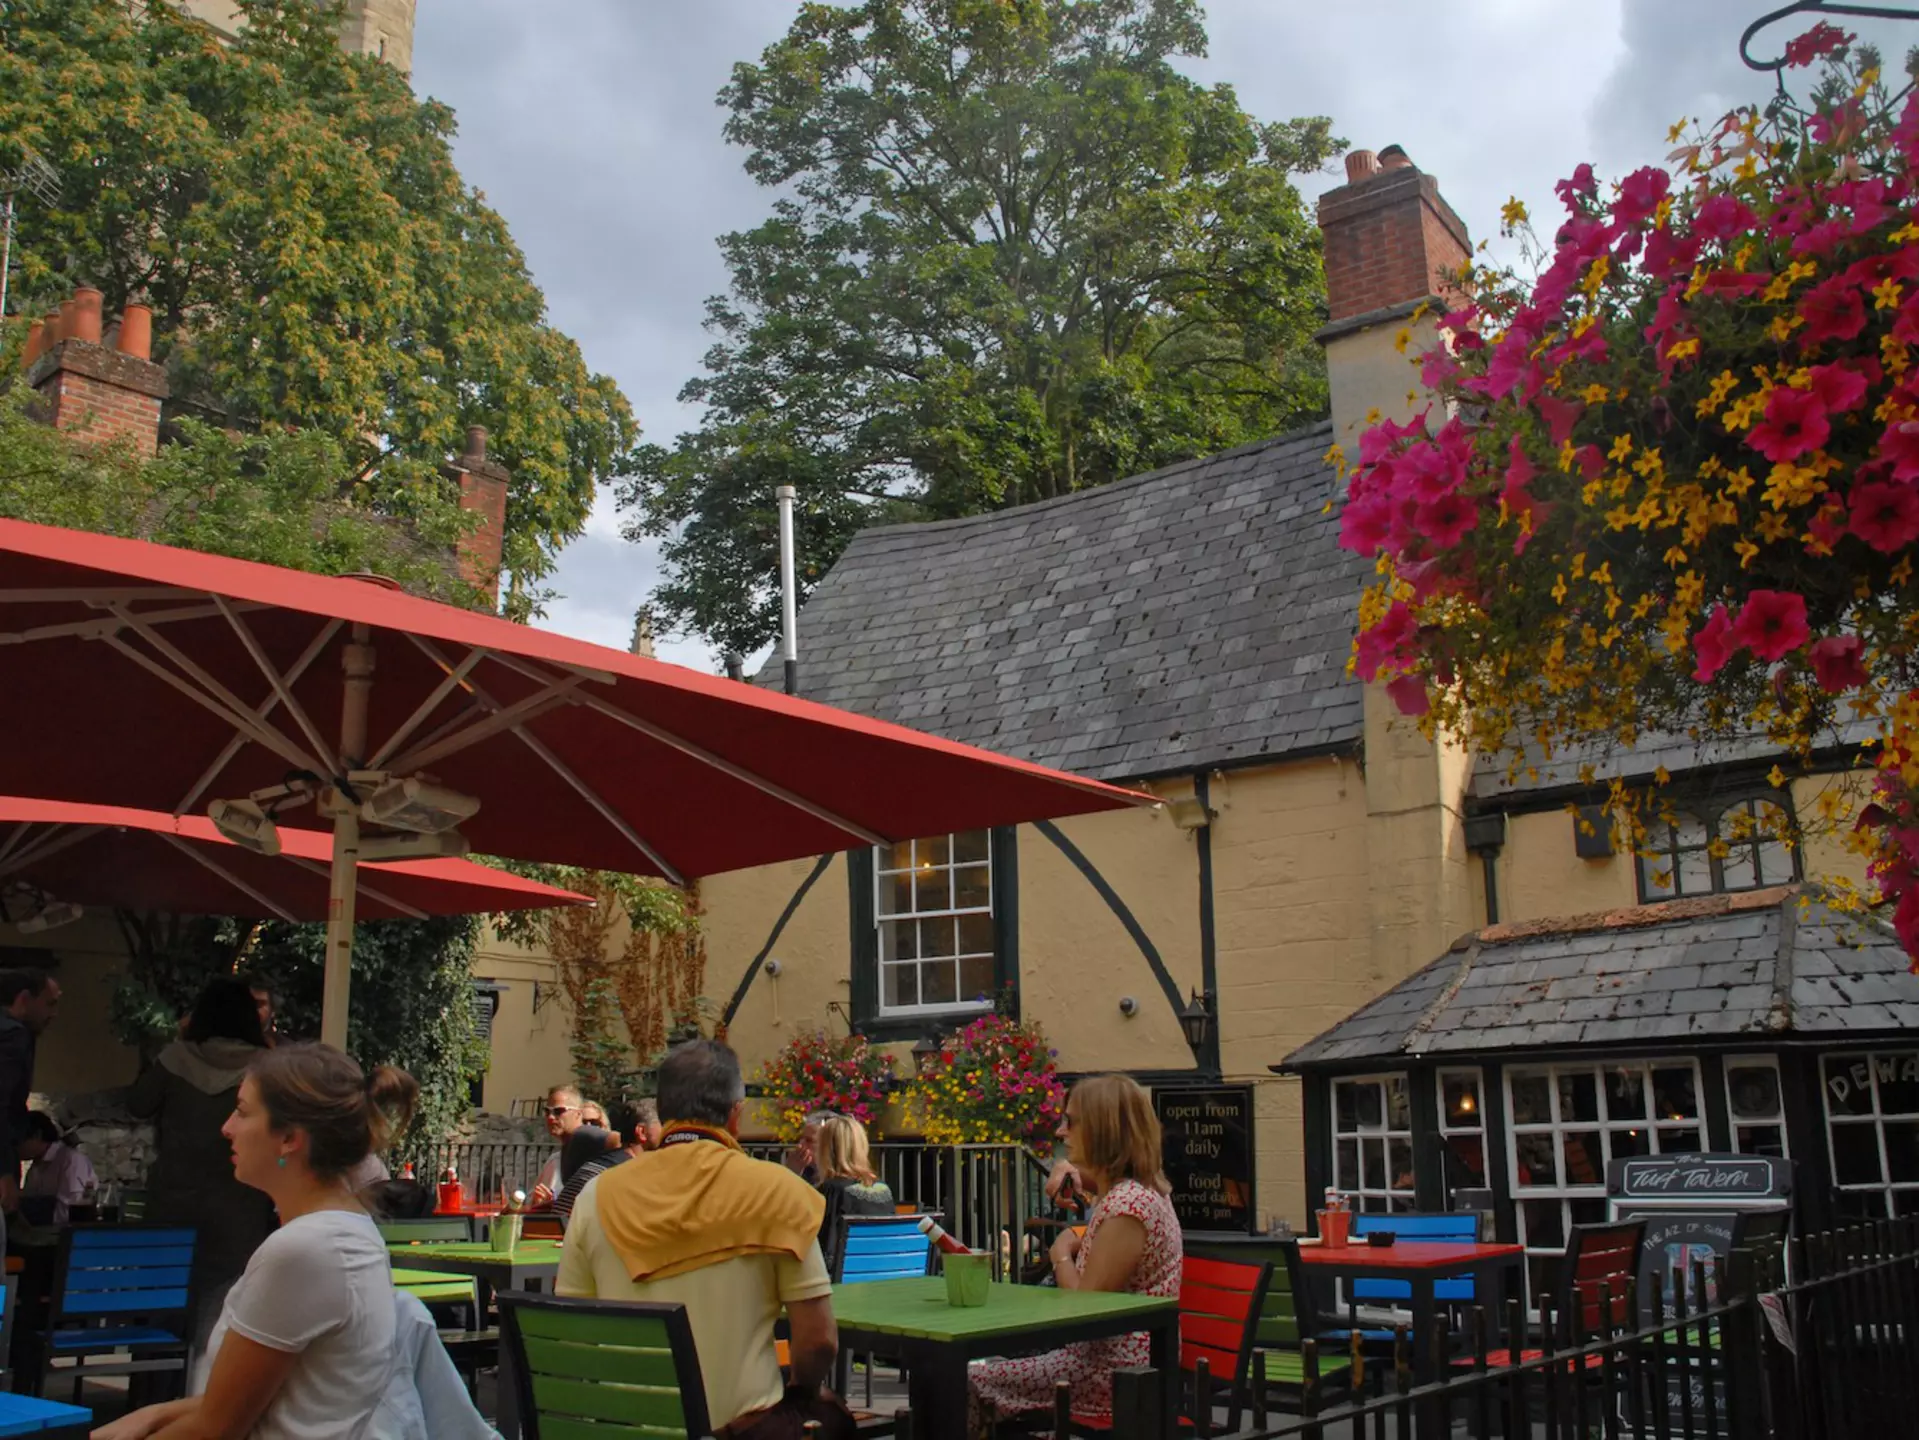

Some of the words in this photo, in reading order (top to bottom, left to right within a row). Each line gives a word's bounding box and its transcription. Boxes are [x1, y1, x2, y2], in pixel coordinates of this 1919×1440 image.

[1166, 1105, 1200, 1120] open
[1205, 1102, 1239, 1117] from
[1184, 1121, 1223, 1135] 11am
[1185, 1139, 1221, 1159] daily
[1188, 1173, 1221, 1189] food
[1632, 1167, 1680, 1190] Turf
[1681, 1167, 1750, 1189] Tavern
